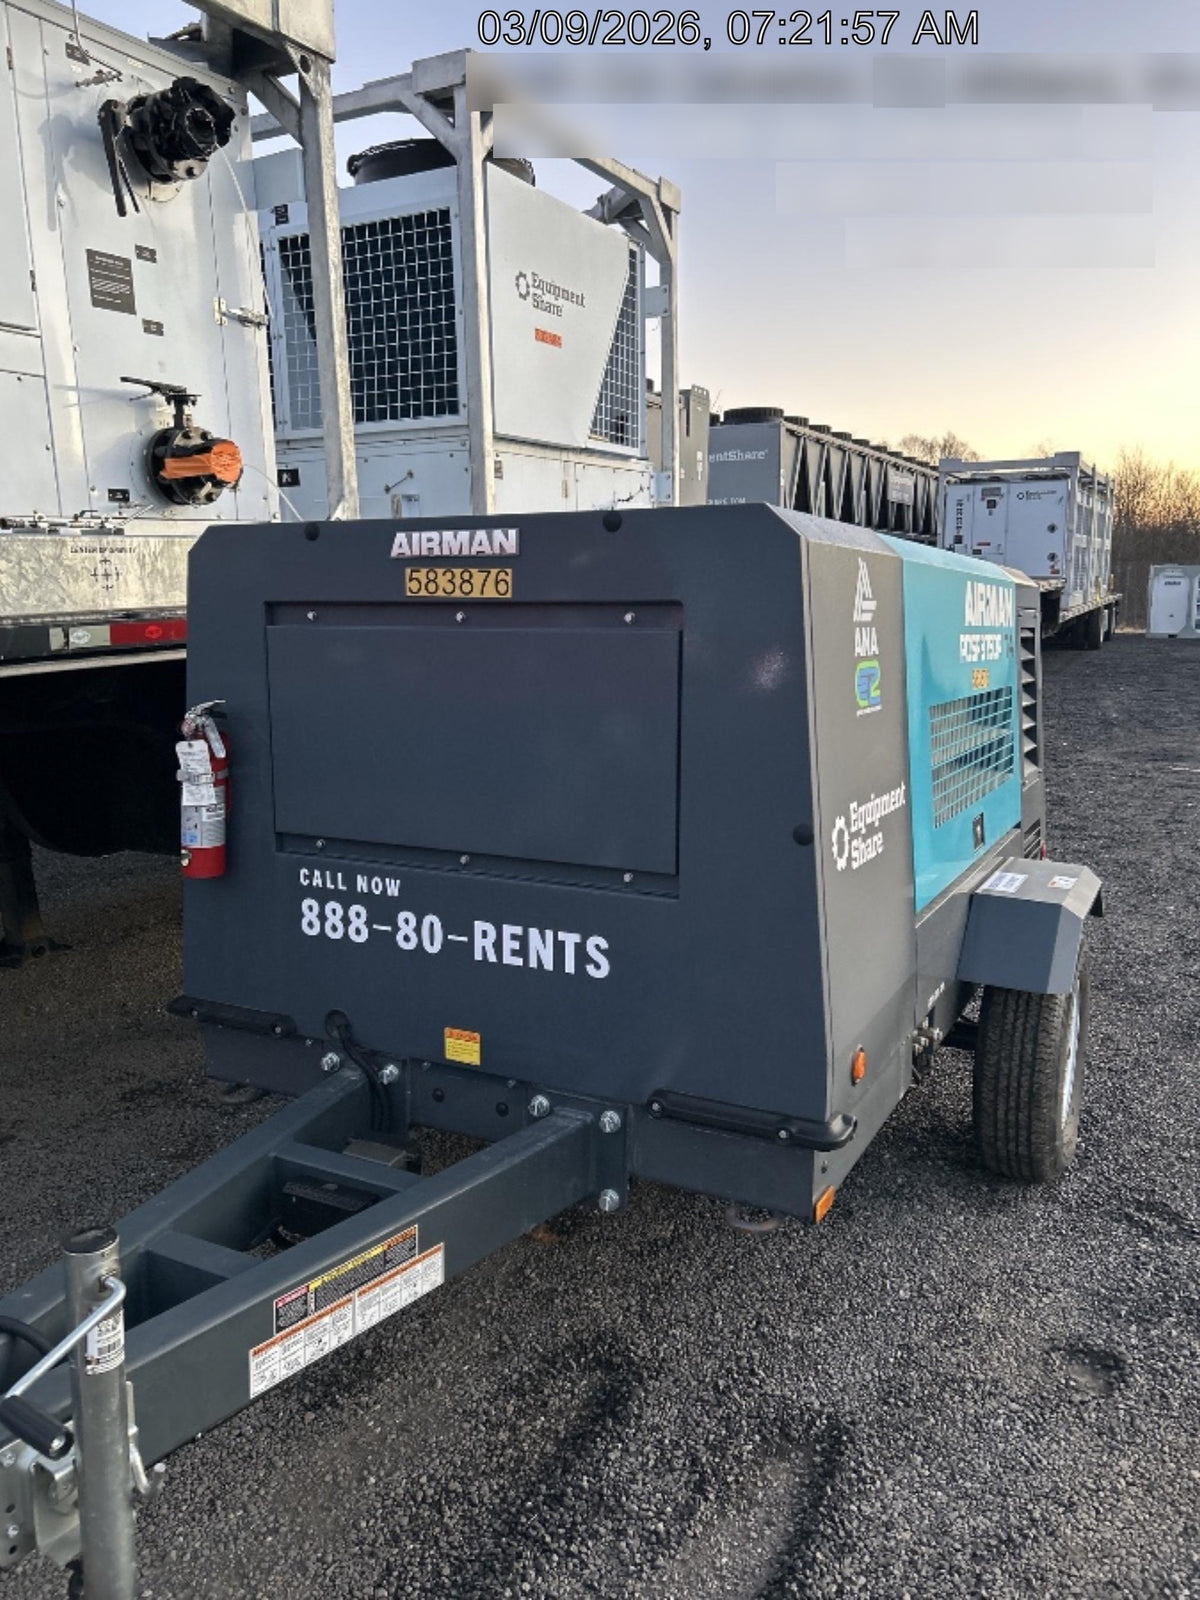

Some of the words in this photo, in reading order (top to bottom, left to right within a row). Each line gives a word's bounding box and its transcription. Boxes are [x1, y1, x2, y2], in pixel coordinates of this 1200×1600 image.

[531, 271, 586, 308] Equipment
[532, 292, 563, 317] Share
[390, 528, 519, 558] AIRMAN
[408, 568, 509, 596] 583876
[964, 580, 1013, 627] AIRMAN
[854, 627, 879, 657] ANA
[849, 780, 906, 834] Equipment
[851, 831, 884, 870] Share
[299, 867, 347, 891] CALL
[356, 873, 401, 897] NOW
[300, 897, 611, 979] 888-80-RENTS
